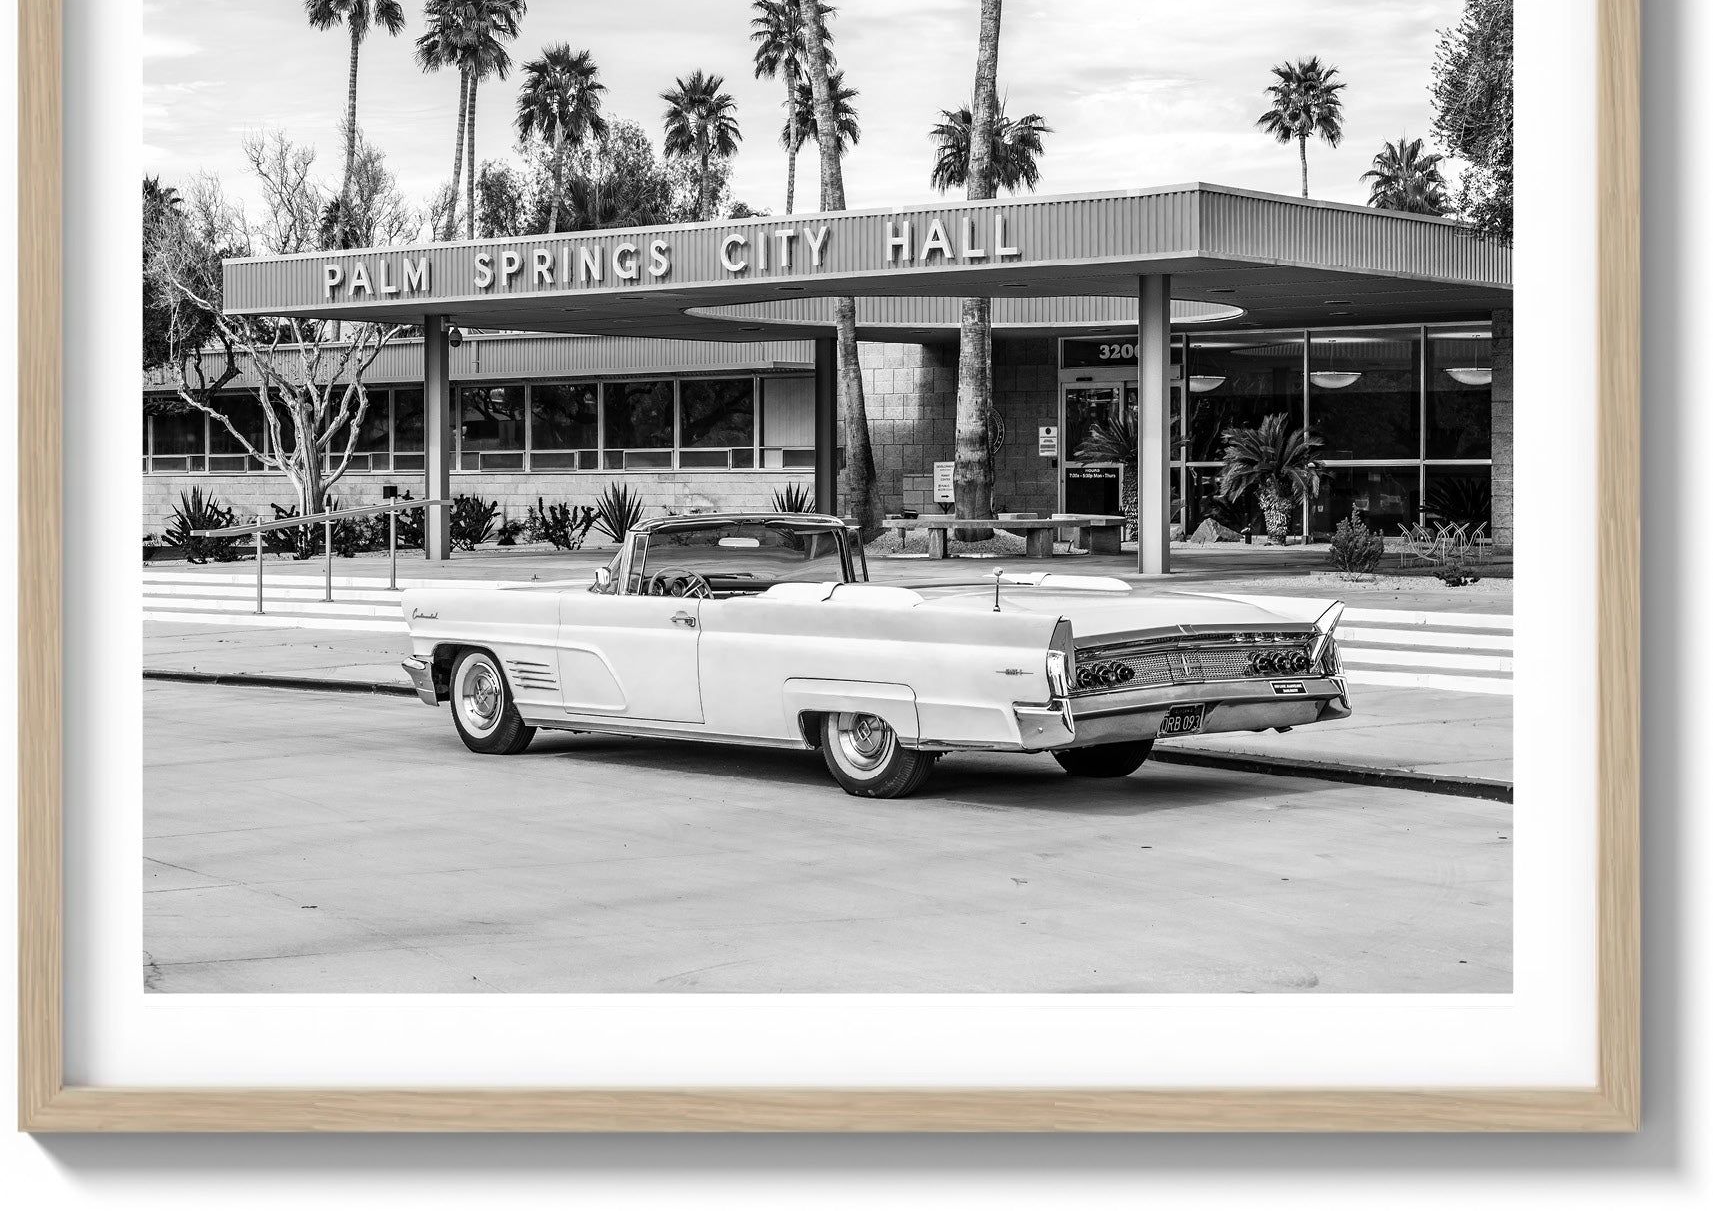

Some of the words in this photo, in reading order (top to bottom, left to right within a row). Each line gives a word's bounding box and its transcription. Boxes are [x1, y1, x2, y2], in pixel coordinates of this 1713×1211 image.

[324, 257, 431, 297] PALM
[473, 240, 672, 289] SPRINGS
[720, 226, 830, 272] CITY
[886, 214, 1022, 262] HALL
[1182, 715, 1200, 730] 093
